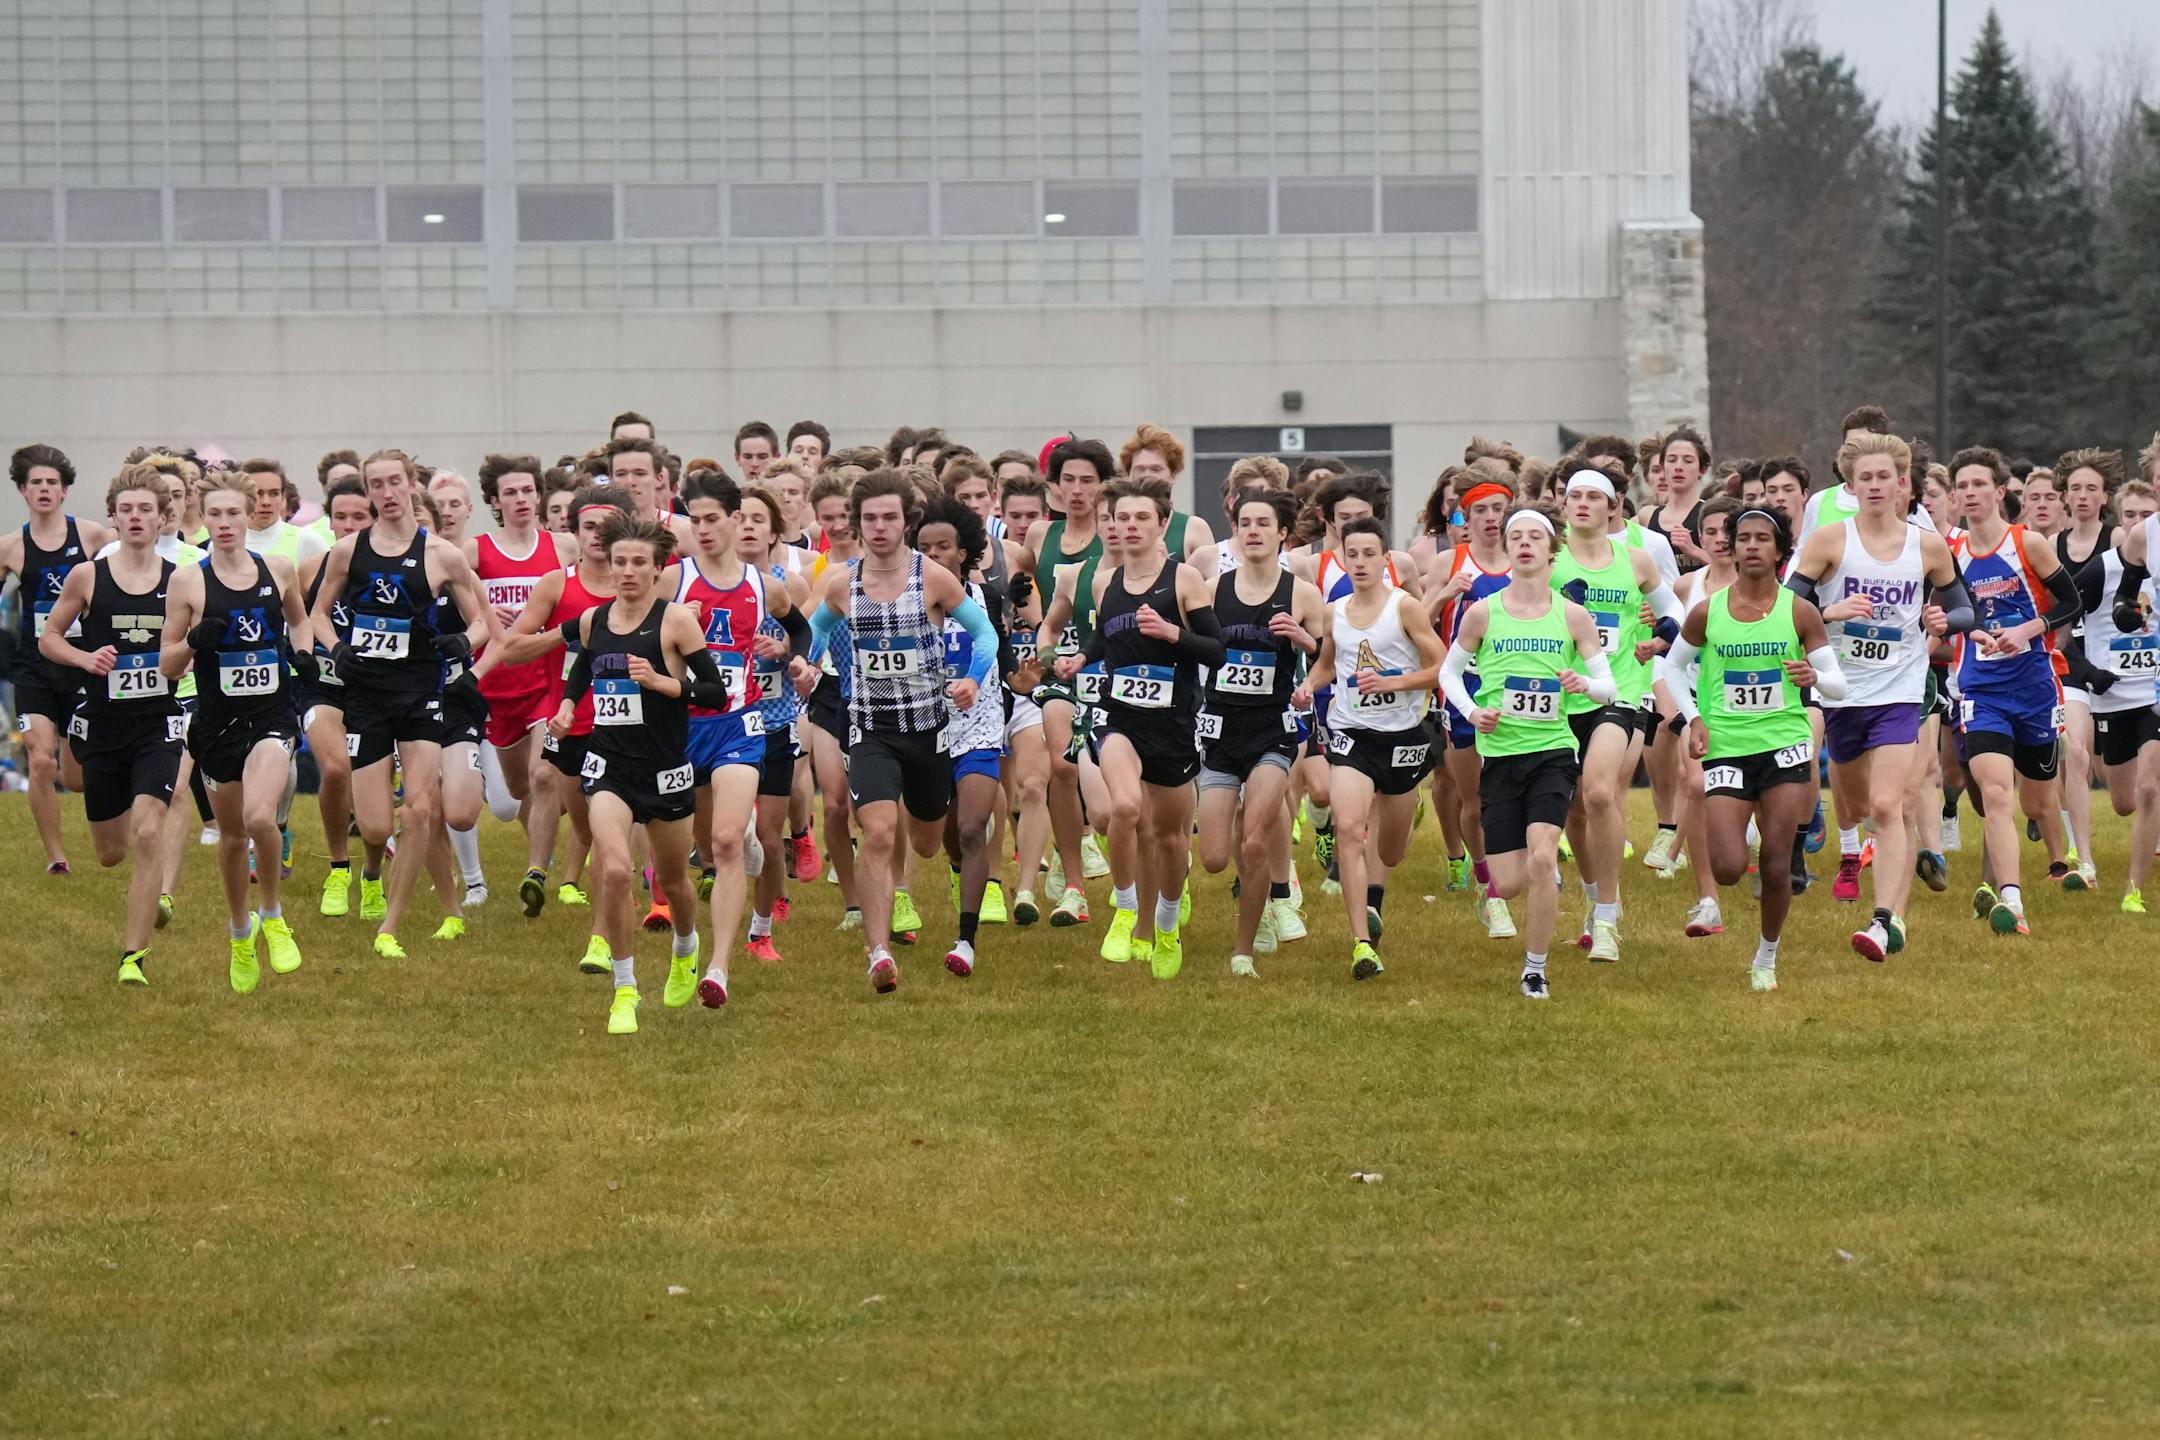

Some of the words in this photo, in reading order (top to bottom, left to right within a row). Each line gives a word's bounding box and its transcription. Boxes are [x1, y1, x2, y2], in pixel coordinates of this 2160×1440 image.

[1287, 430, 1298, 446] 5
[1844, 576, 1918, 605] BISON
[1863, 578, 1903, 587] BUFFALO
[488, 584, 533, 605] CENTEN
[705, 607, 735, 647] A
[362, 631, 398, 652] 274
[1493, 638, 1563, 654] WOODBURY
[1714, 641, 1787, 658] WOODBURY
[1851, 639, 1890, 660] 380
[868, 652, 906, 671] 219
[1356, 638, 1387, 673] A
[2119, 651, 2155, 669] 243
[119, 670, 157, 691] 216
[232, 667, 270, 688] 269
[1226, 666, 1264, 687] 233
[1122, 678, 1161, 701] 232
[1359, 690, 1396, 707] 236
[1734, 686, 1773, 706] 317
[598, 697, 630, 717] 234
[1513, 693, 1551, 714] 313
[1398, 748, 1425, 764] 236
[1780, 743, 1808, 765] 317
[664, 767, 692, 790] 234
[1708, 769, 1736, 787] 317
